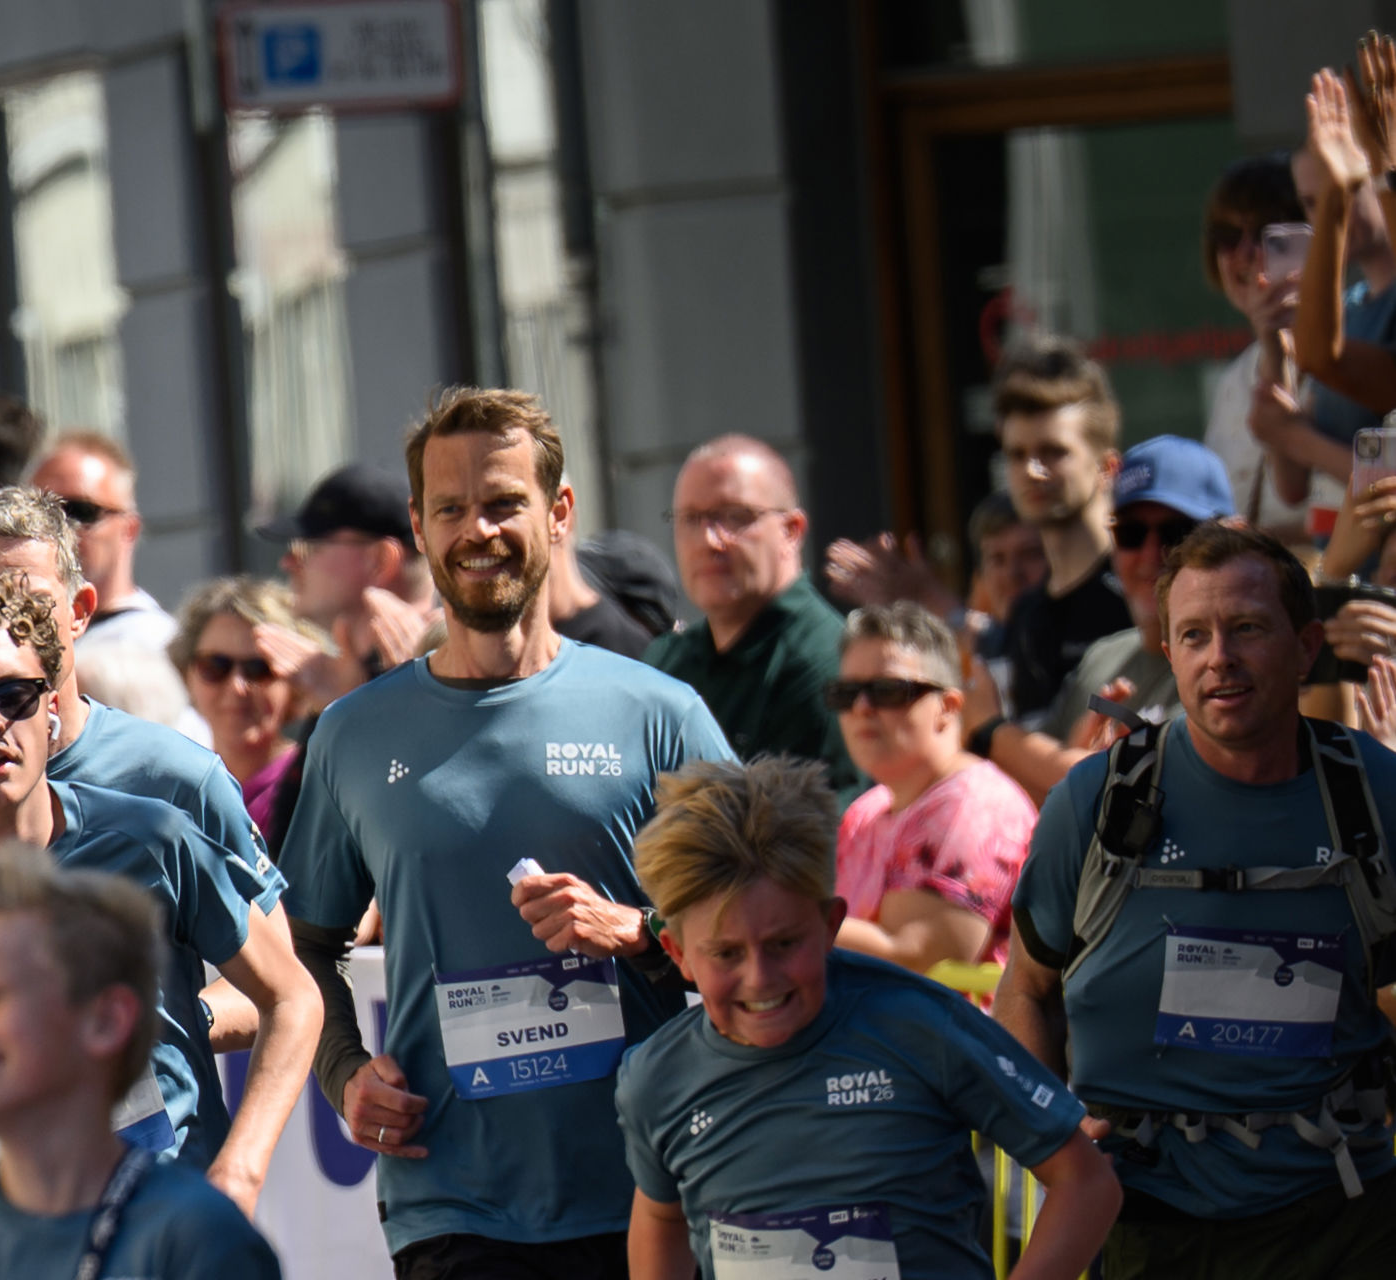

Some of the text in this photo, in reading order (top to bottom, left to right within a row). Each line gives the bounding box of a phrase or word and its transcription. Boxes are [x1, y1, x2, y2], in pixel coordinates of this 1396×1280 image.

[546, 743, 622, 760] ROYAL
[1177, 943, 1216, 954] ROYAL
[447, 986, 485, 999] ROYAL
[497, 1022, 569, 1047] SVEND
[1178, 1021, 1284, 1045] A 20477
[472, 1067, 490, 1086] A
[508, 1053, 568, 1080] 15124
[826, 1069, 892, 1093] ROYAL
